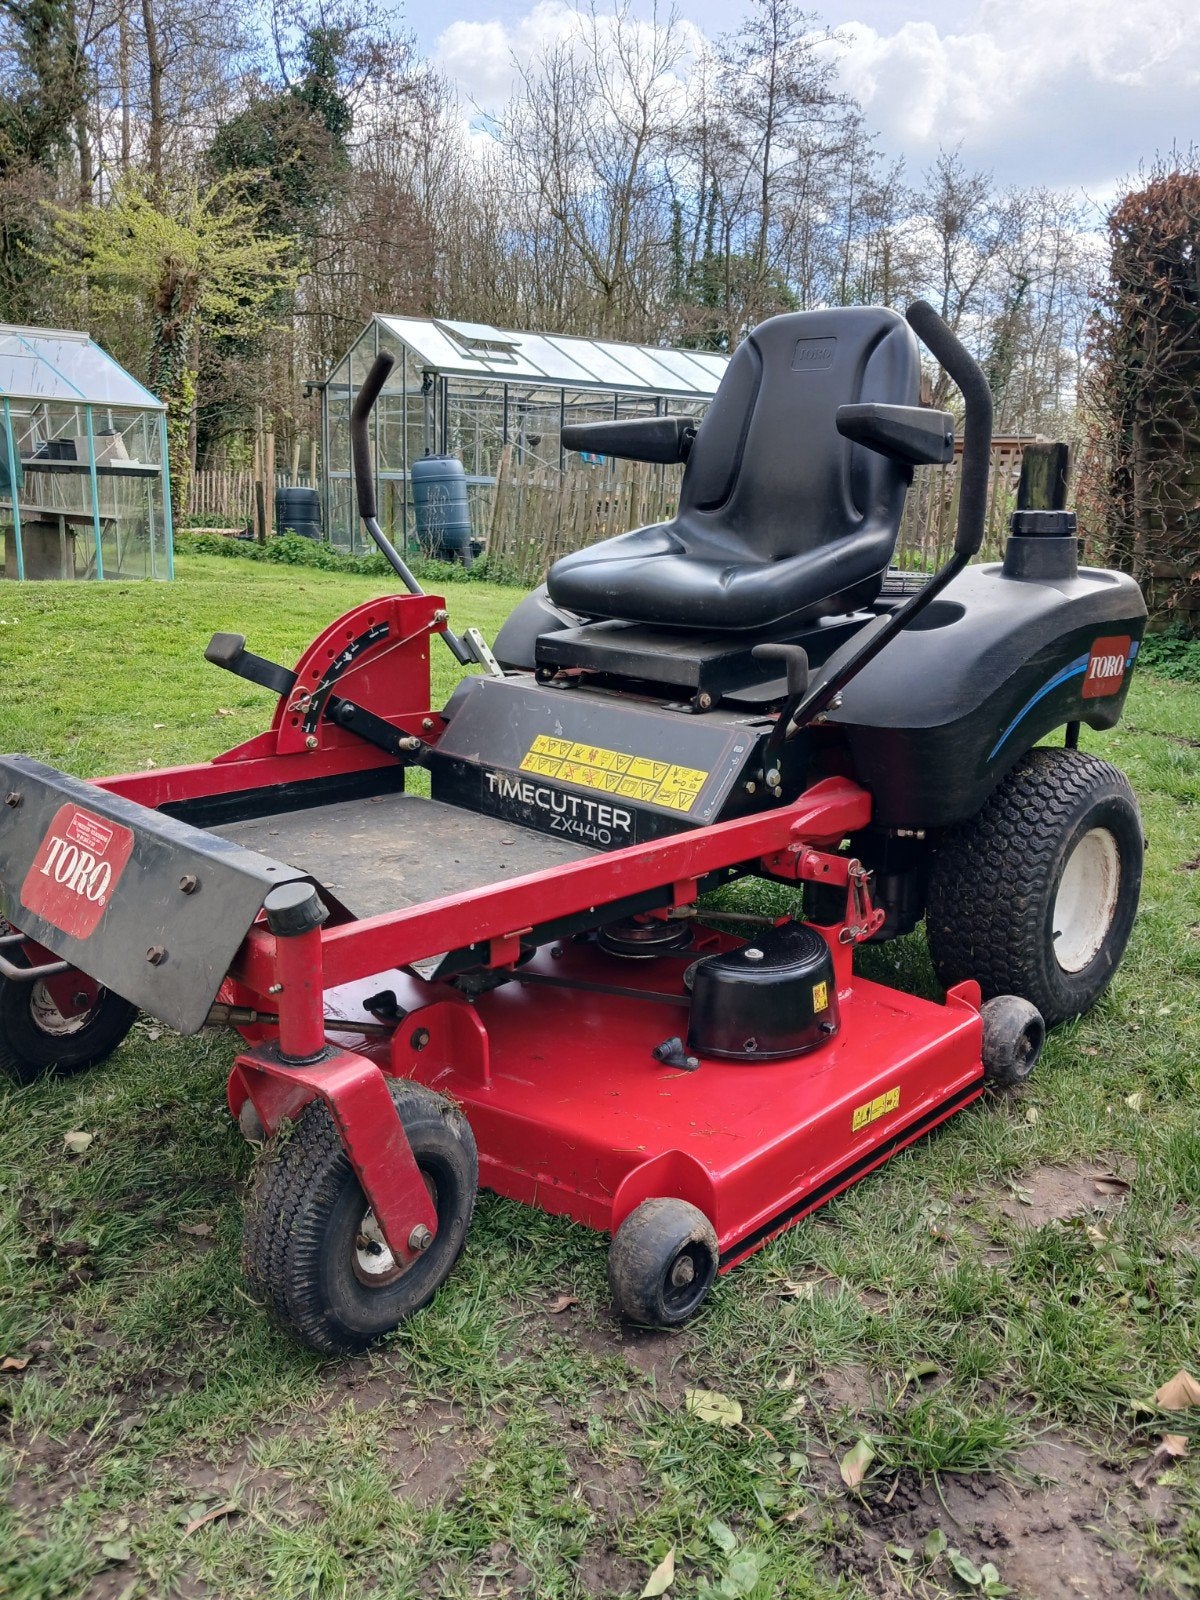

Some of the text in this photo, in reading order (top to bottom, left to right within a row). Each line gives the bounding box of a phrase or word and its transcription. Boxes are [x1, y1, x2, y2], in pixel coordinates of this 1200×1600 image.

[1089, 655, 1125, 679] TORO
[486, 774, 631, 832] TIMECUTTER
[550, 815, 611, 844] ZX440
[40, 836, 111, 902] TORO
